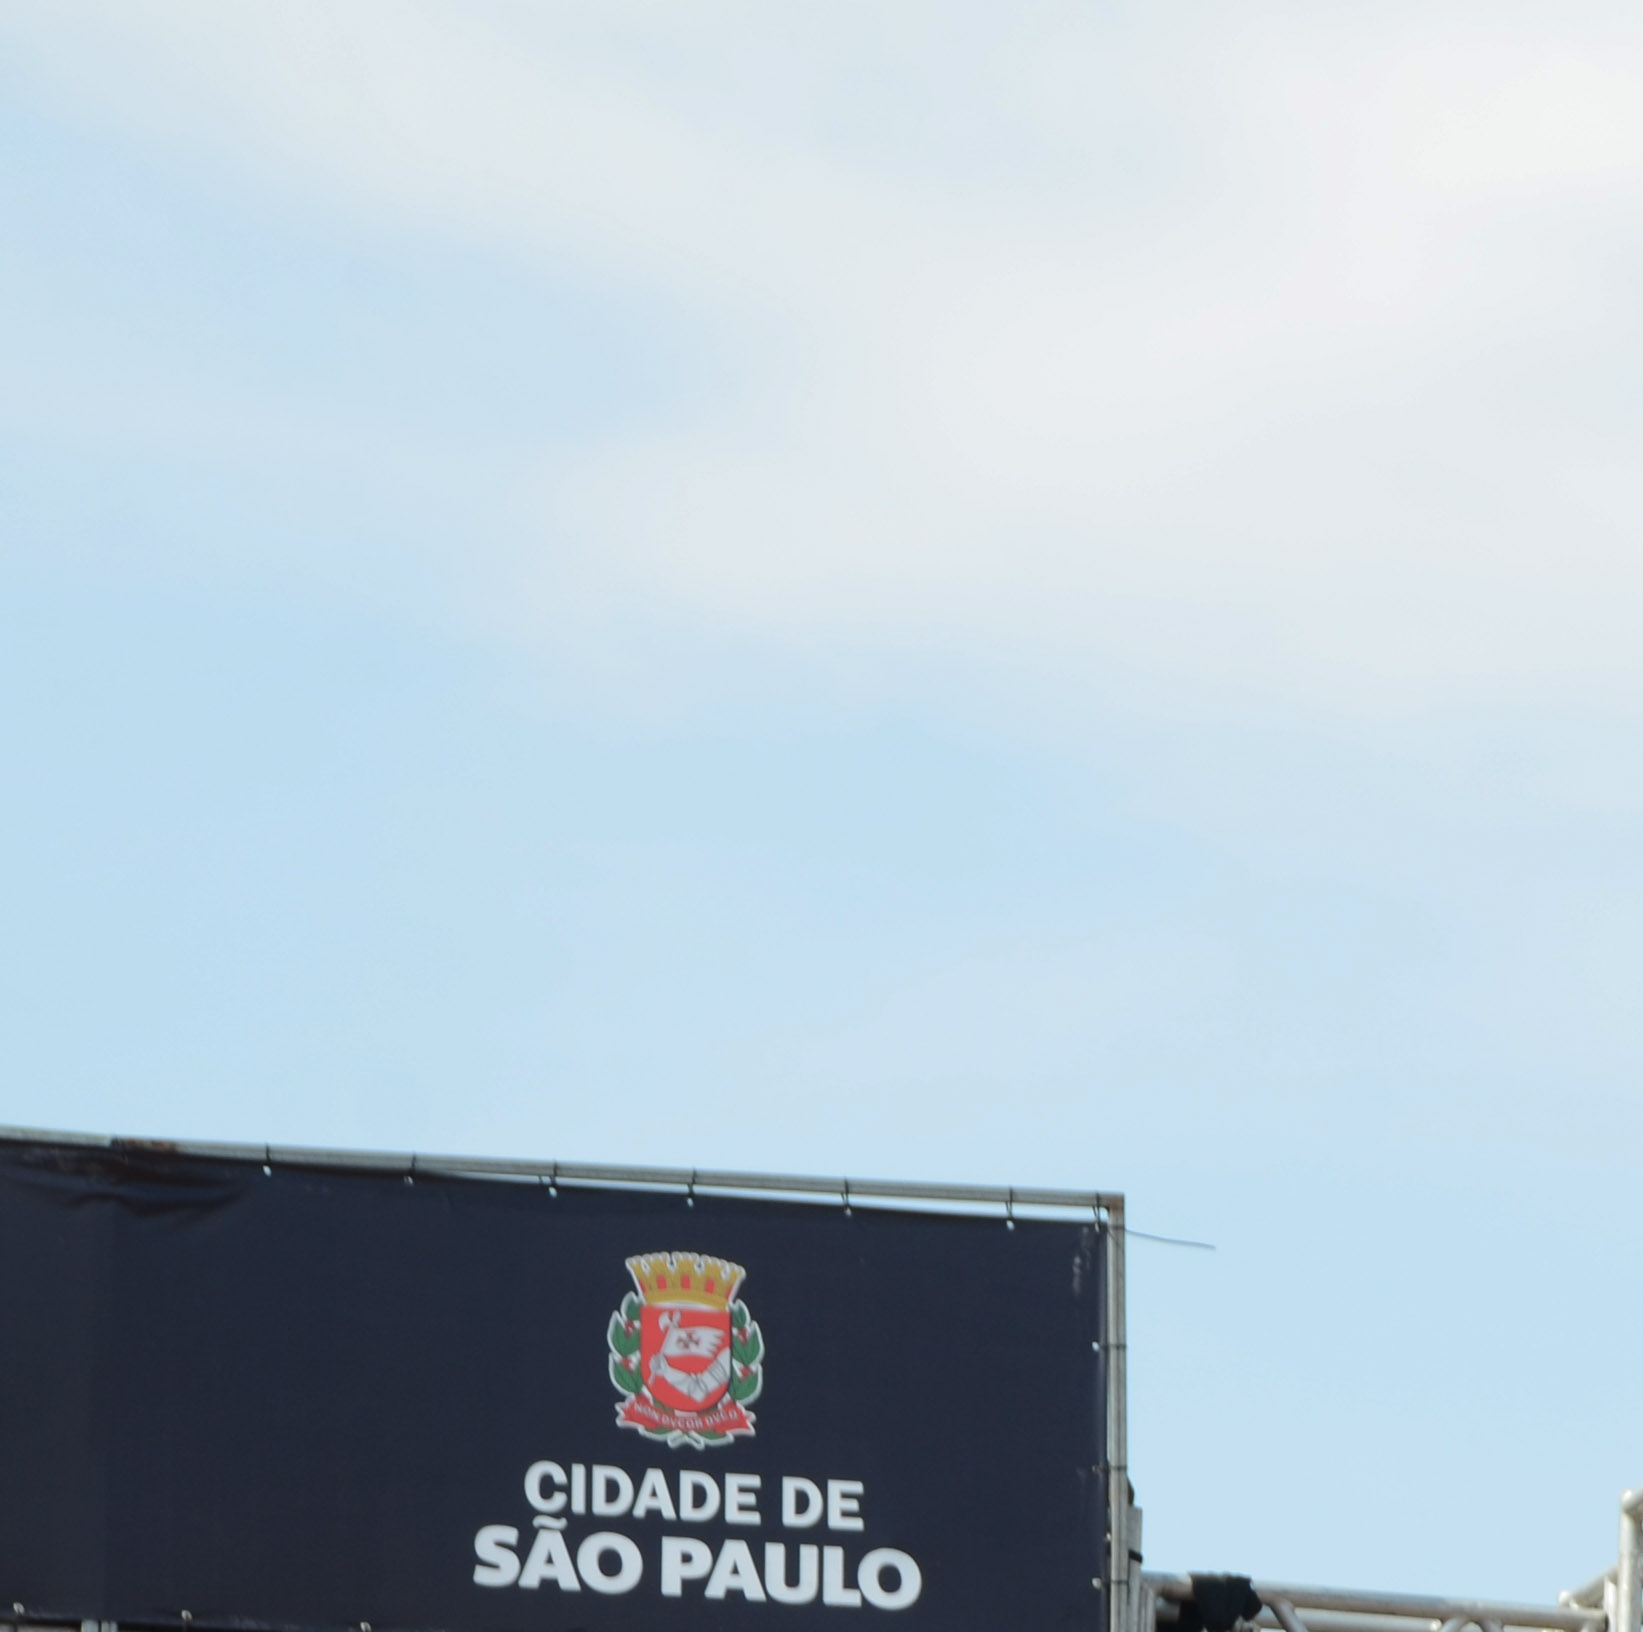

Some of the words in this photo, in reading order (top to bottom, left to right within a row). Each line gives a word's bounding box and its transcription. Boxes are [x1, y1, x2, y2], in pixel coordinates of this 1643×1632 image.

[524, 1459, 762, 1525] CIDADE
[782, 1476, 865, 1531] DE
[472, 1514, 644, 1595] SÃO
[660, 1535, 923, 1611] PAULO
